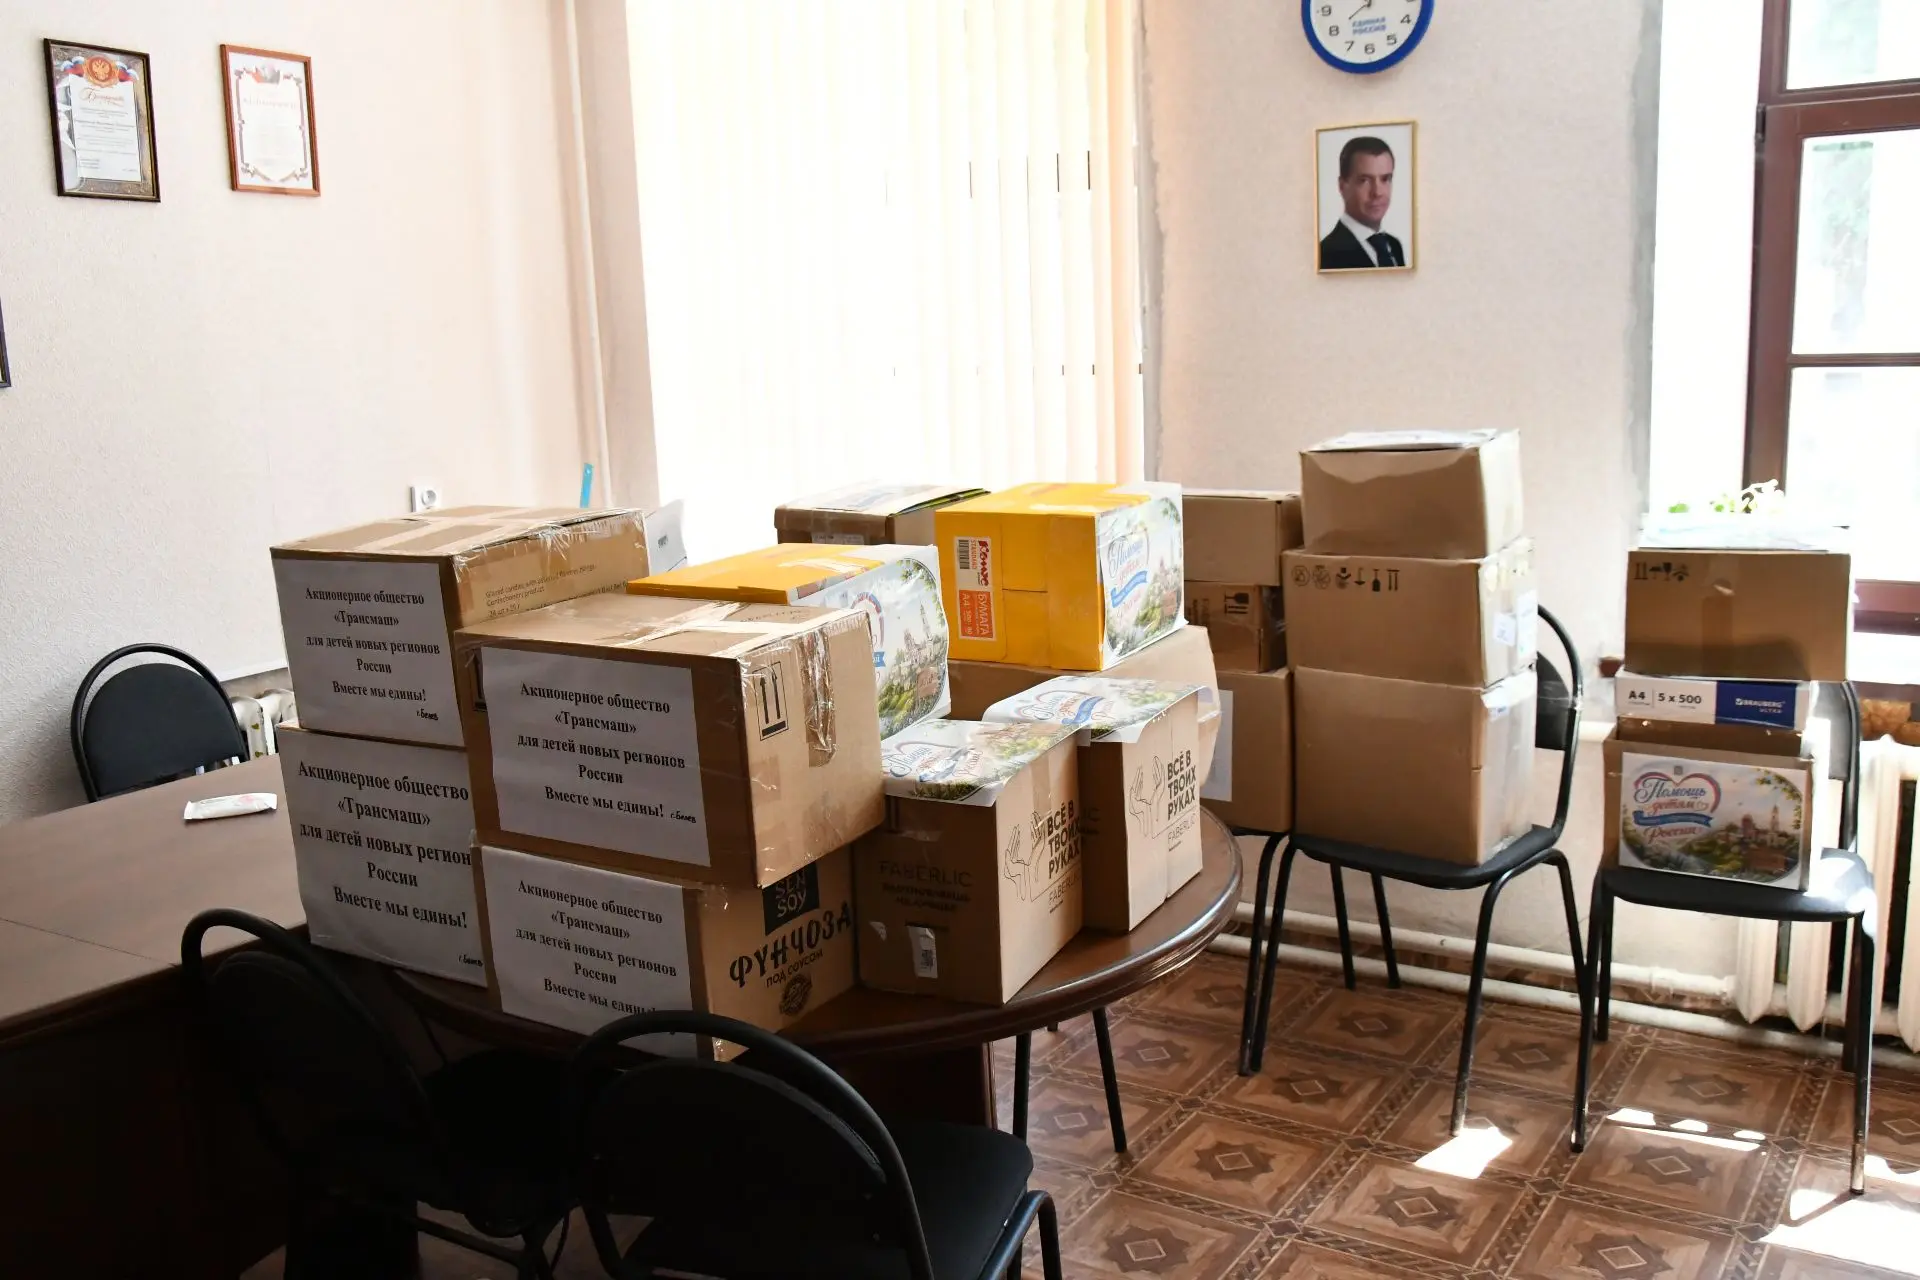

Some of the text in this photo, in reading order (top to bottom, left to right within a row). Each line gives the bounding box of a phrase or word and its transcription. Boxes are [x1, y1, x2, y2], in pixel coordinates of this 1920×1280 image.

[1322, 6, 1332, 16] 9
[1400, 14, 1411, 24] 4
[1329, 25, 1340, 36] 8
[1386, 34, 1397, 45] 5
[1345, 40, 1354, 52] 7
[1364, 43, 1375, 54] 6
[306, 588, 424, 604] Акционерное общество
[334, 610, 399, 626] «Трансмаш»
[978, 594, 989, 635] БУМАГА
[306, 636, 440, 655] для детей новых регионов
[356, 658, 392, 674] России
[332, 681, 427, 701] Вместе мы едины!
[520, 683, 670, 714] Акционерное общество
[1629, 690, 1646, 700] A4
[1658, 693, 1665, 702] 5
[1679, 694, 1702, 704] 500
[554, 711, 637, 734] «Трансмаш»
[517, 734, 686, 769] для детей новых регионов
[1167, 750, 1191, 780] ВСЁ В
[298, 761, 469, 800] Акционерное общество
[578, 763, 624, 784] России
[1168, 765, 1196, 799] ТВОИХ
[544, 786, 589, 805] Вместе
[592, 797, 613, 810] мы
[617, 802, 664, 818] едины!
[1168, 785, 1195, 820] РУКАХ
[1633, 777, 1706, 804] Помощь
[337, 796, 431, 826] «Трансмаш»
[1047, 802, 1066, 837] ВСЁ
[1068, 800, 1074, 820] В
[300, 823, 472, 866] для детей новых регион
[1048, 816, 1080, 857] ТВОИХ
[1049, 836, 1080, 879] РУКАХ
[367, 861, 418, 887] России
[879, 860, 972, 886] FABERLIC
[333, 886, 468, 928] Вместе мы едины!
[518, 880, 663, 924] Акционерное общество
[778, 888, 807, 918] SOY
[551, 910, 630, 939] «Трансмаш»
[516, 928, 677, 977] для детей новых регионов
[729, 901, 852, 988] ФУНЧОЗА
[574, 962, 617, 985] России
[766, 949, 823, 988] ПОД СОУСОМ
[544, 978, 586, 1000] Вместе
[588, 993, 608, 1007] мы
